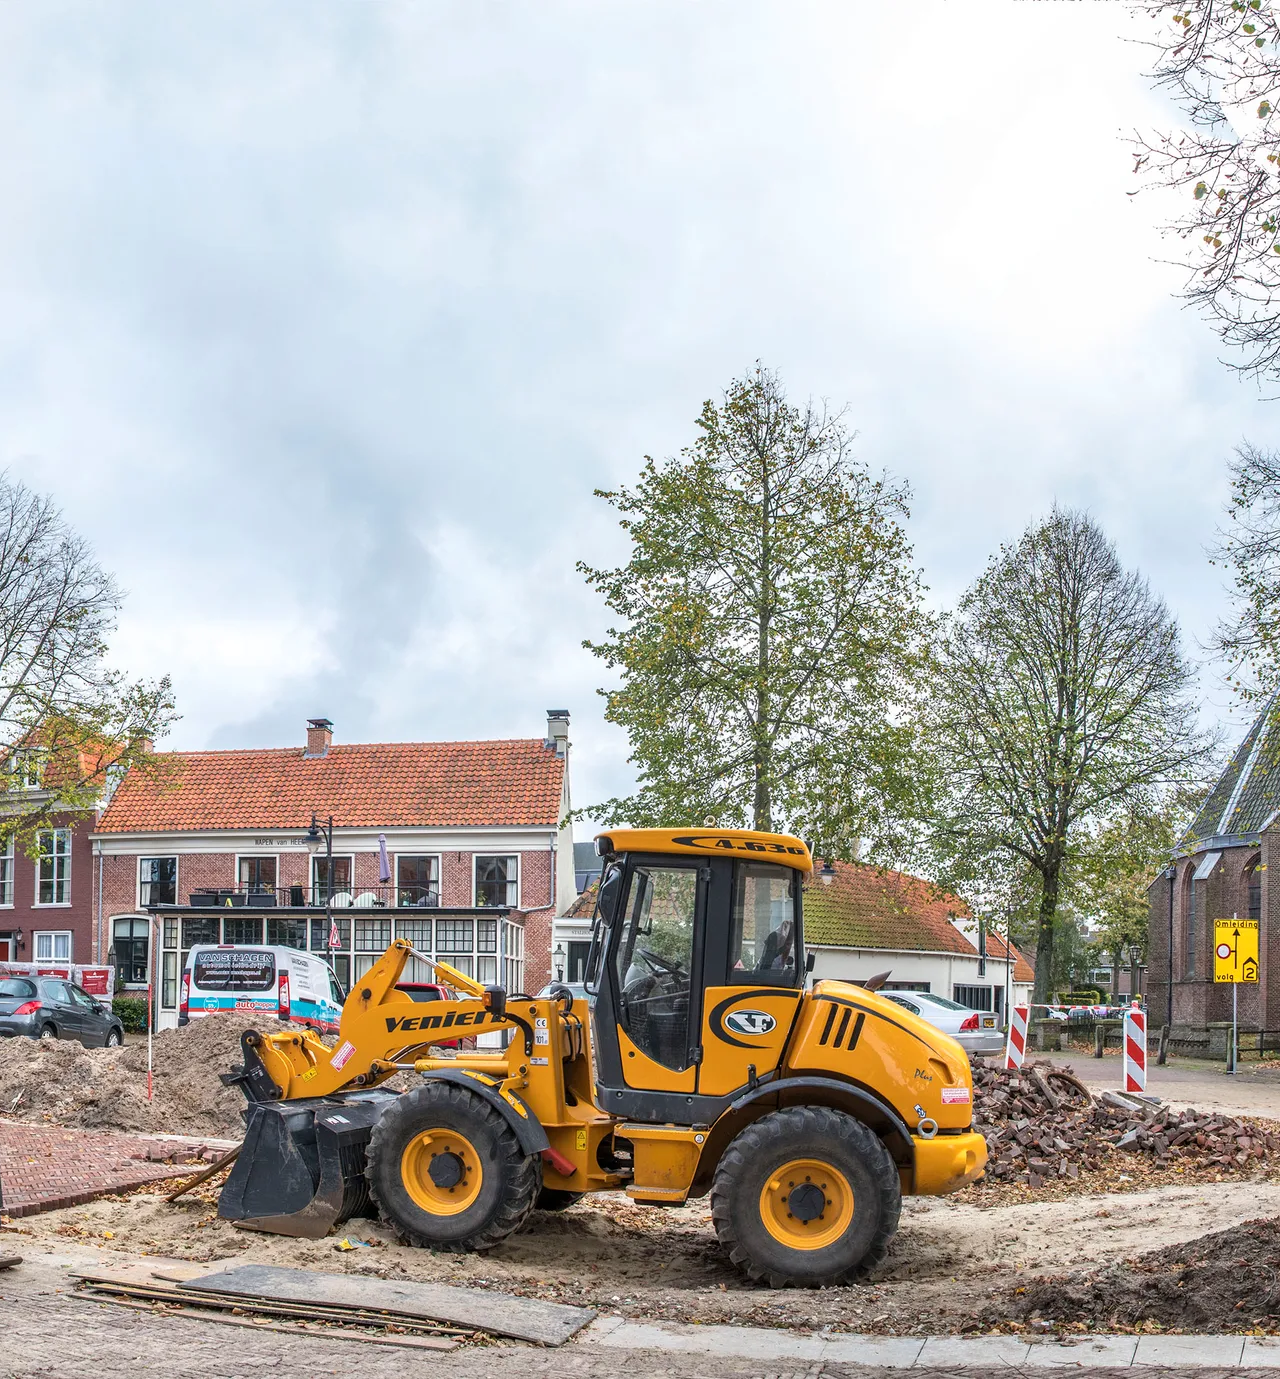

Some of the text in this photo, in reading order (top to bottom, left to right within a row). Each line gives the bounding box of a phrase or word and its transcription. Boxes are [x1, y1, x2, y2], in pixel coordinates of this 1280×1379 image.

[1215, 920, 1258, 929] Omleiding
[198, 953, 273, 962] VAN SCHAGEN
[1216, 973, 1234, 981] volg
[1246, 967, 1255, 979] 2
[914, 1068, 933, 1082] Plus
